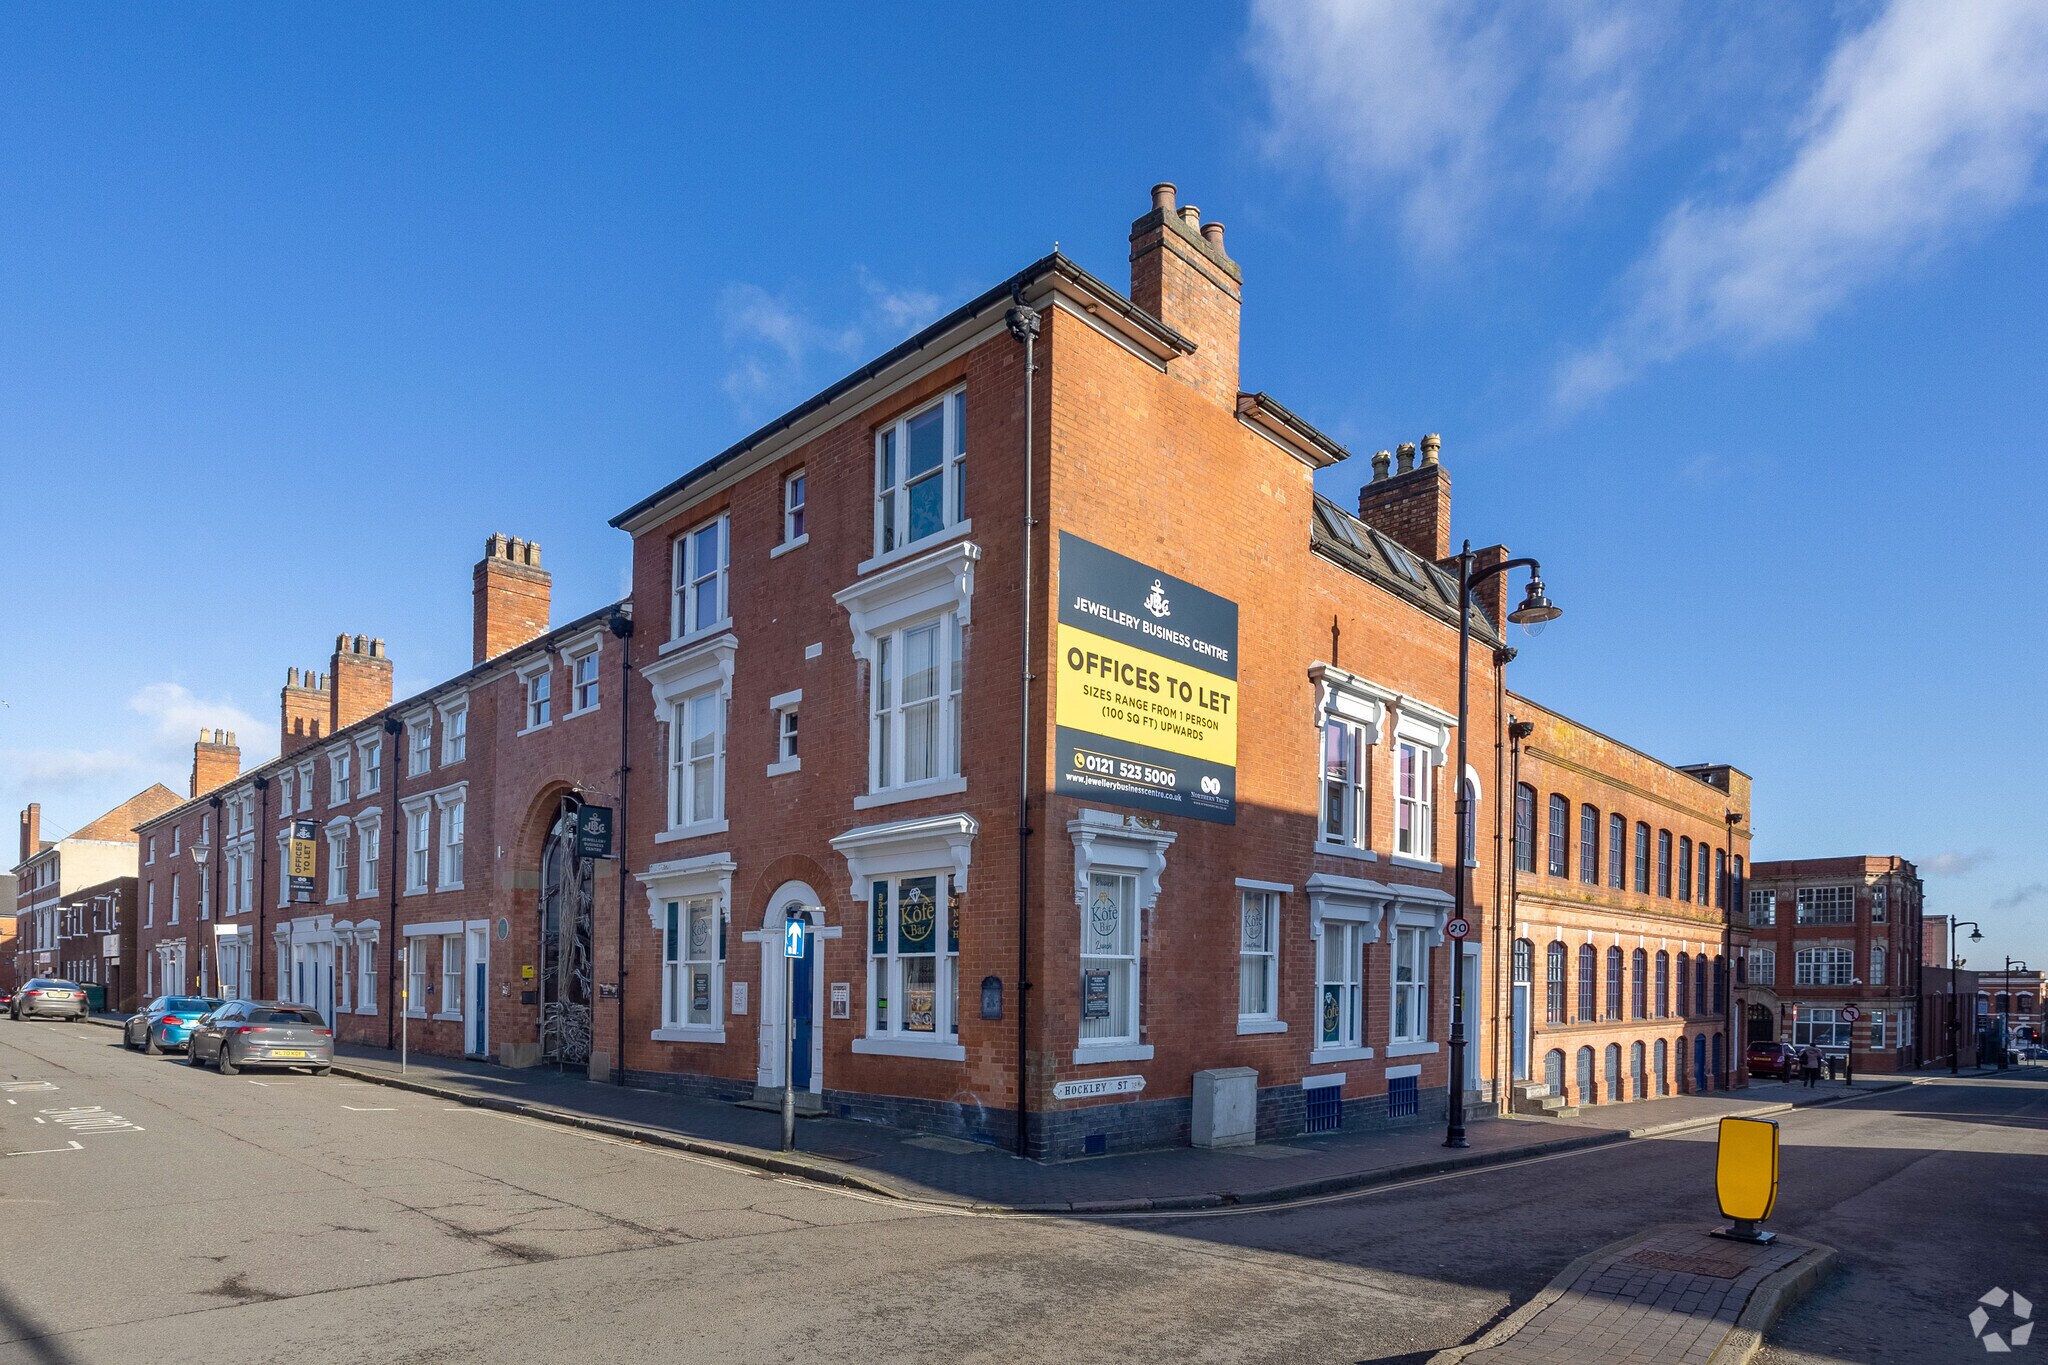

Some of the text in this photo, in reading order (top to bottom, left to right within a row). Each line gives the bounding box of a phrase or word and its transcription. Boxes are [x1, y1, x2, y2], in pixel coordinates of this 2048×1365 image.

[1073, 597, 1229, 662] JEWELLERY BUSINESS CENTRE
[1067, 647, 1231, 714] OFFICES TO LET
[1083, 684, 1219, 731] SIZES RANGE FROM 1 PERSON
[1101, 706, 1204, 741] (100 SQ FT) UPWARDS
[1086, 755, 1176, 787] 0121 523 5000
[1065, 773, 1182, 802] www.jewellerybusinesscentre.co.uk
[303, 859, 310, 871] TO
[910, 924, 926, 936] Bar
[1099, 922, 1112, 932] Bar
[1450, 923, 1467, 933] 20
[1064, 1080, 1128, 1096] HOCKLEY ST
